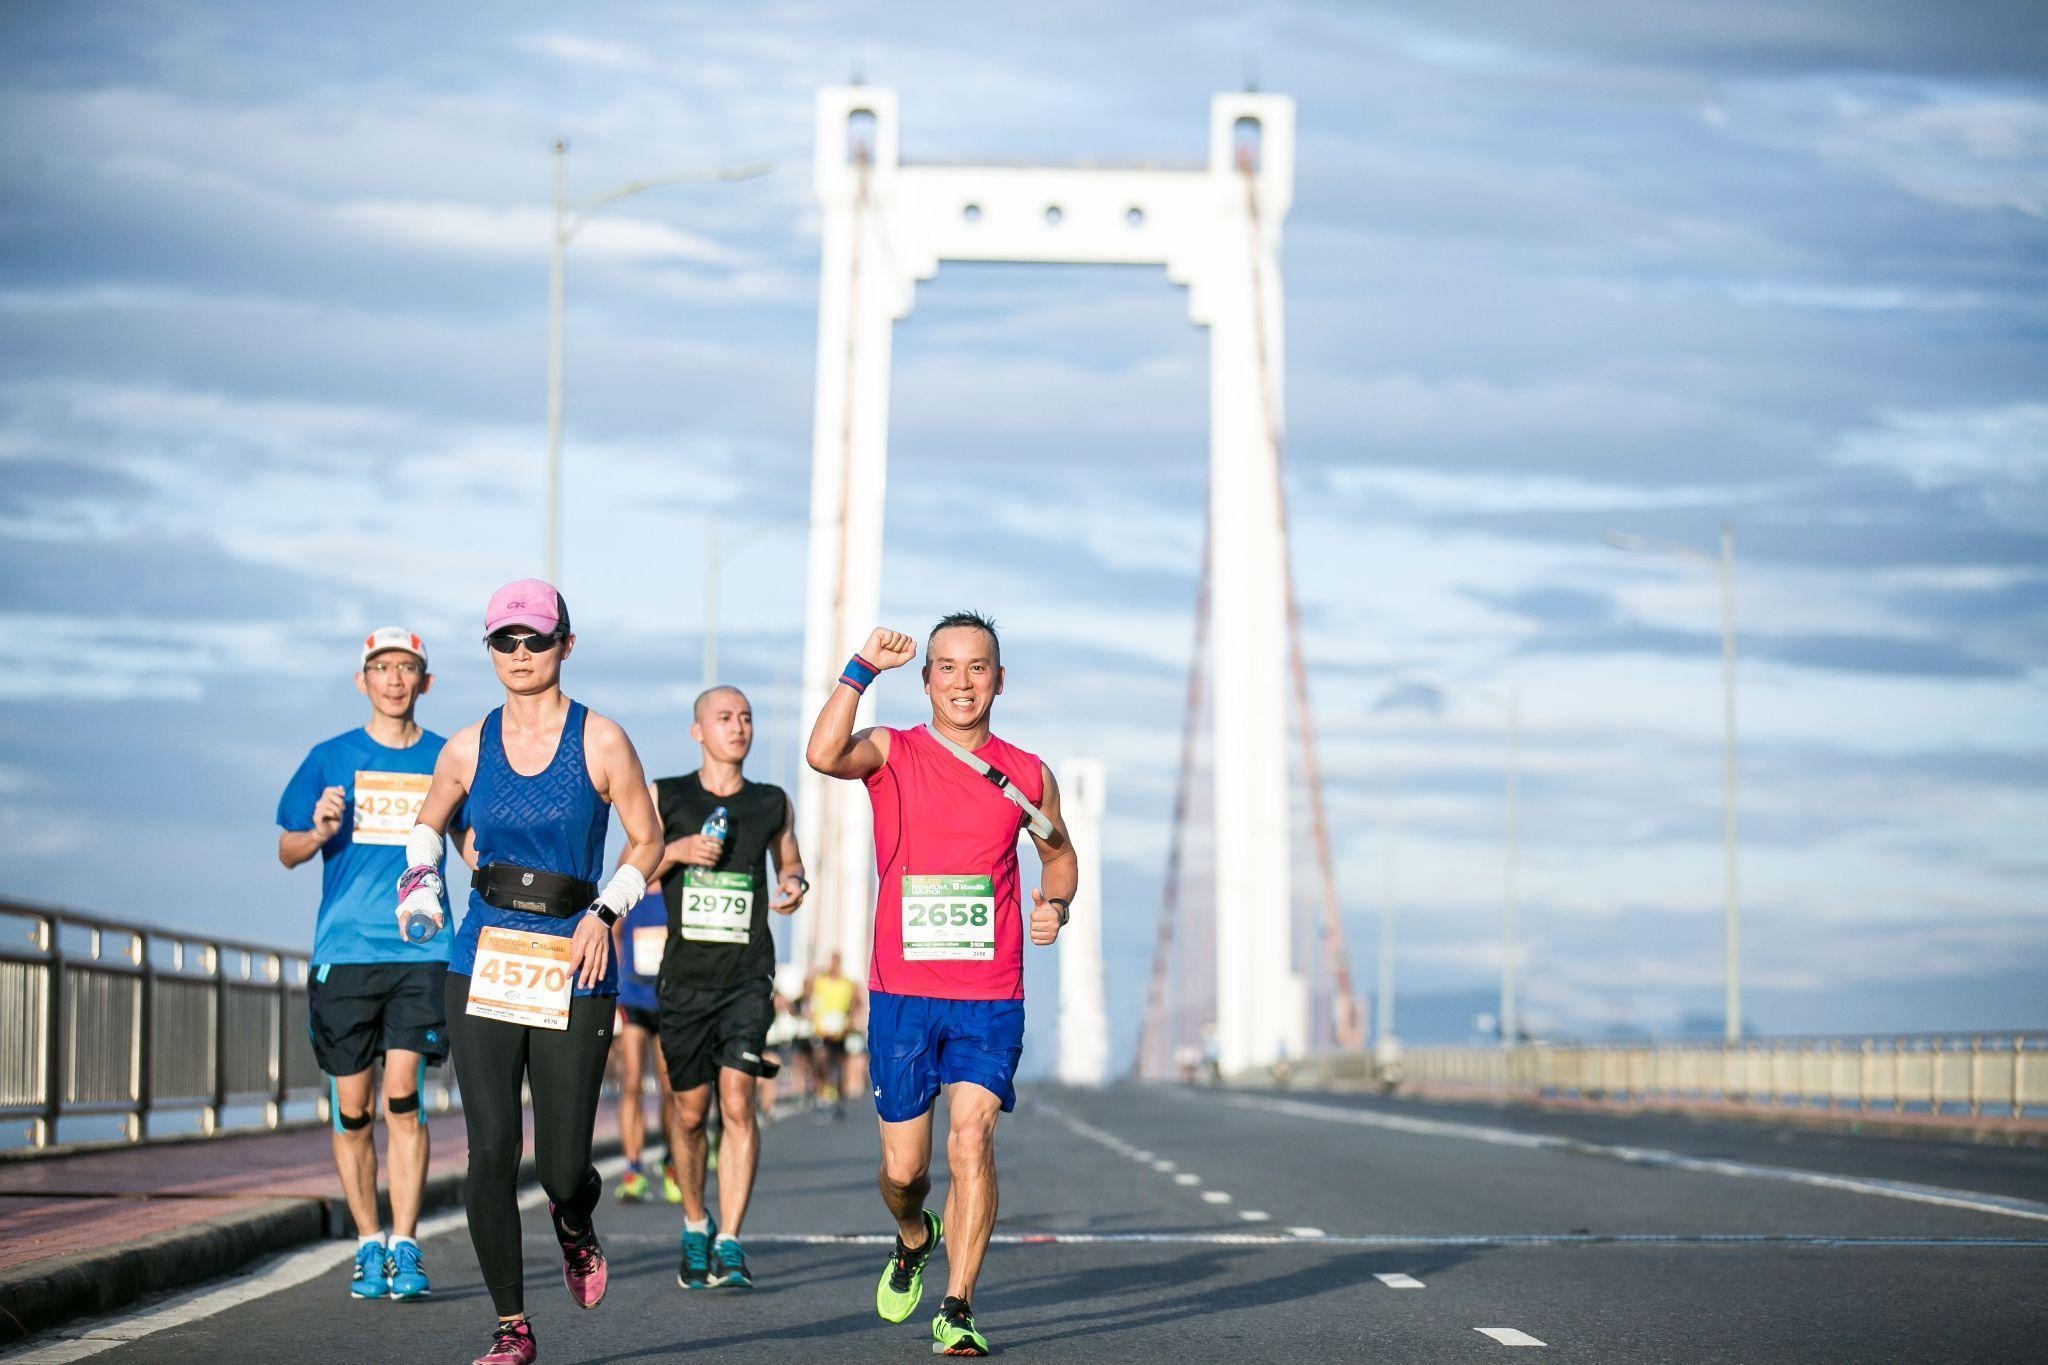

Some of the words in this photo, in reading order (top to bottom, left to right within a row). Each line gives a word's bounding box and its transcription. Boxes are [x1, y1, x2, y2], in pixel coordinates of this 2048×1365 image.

[688, 894, 747, 915] 2979
[908, 903, 988, 927] 2658
[479, 958, 566, 992] 4570
